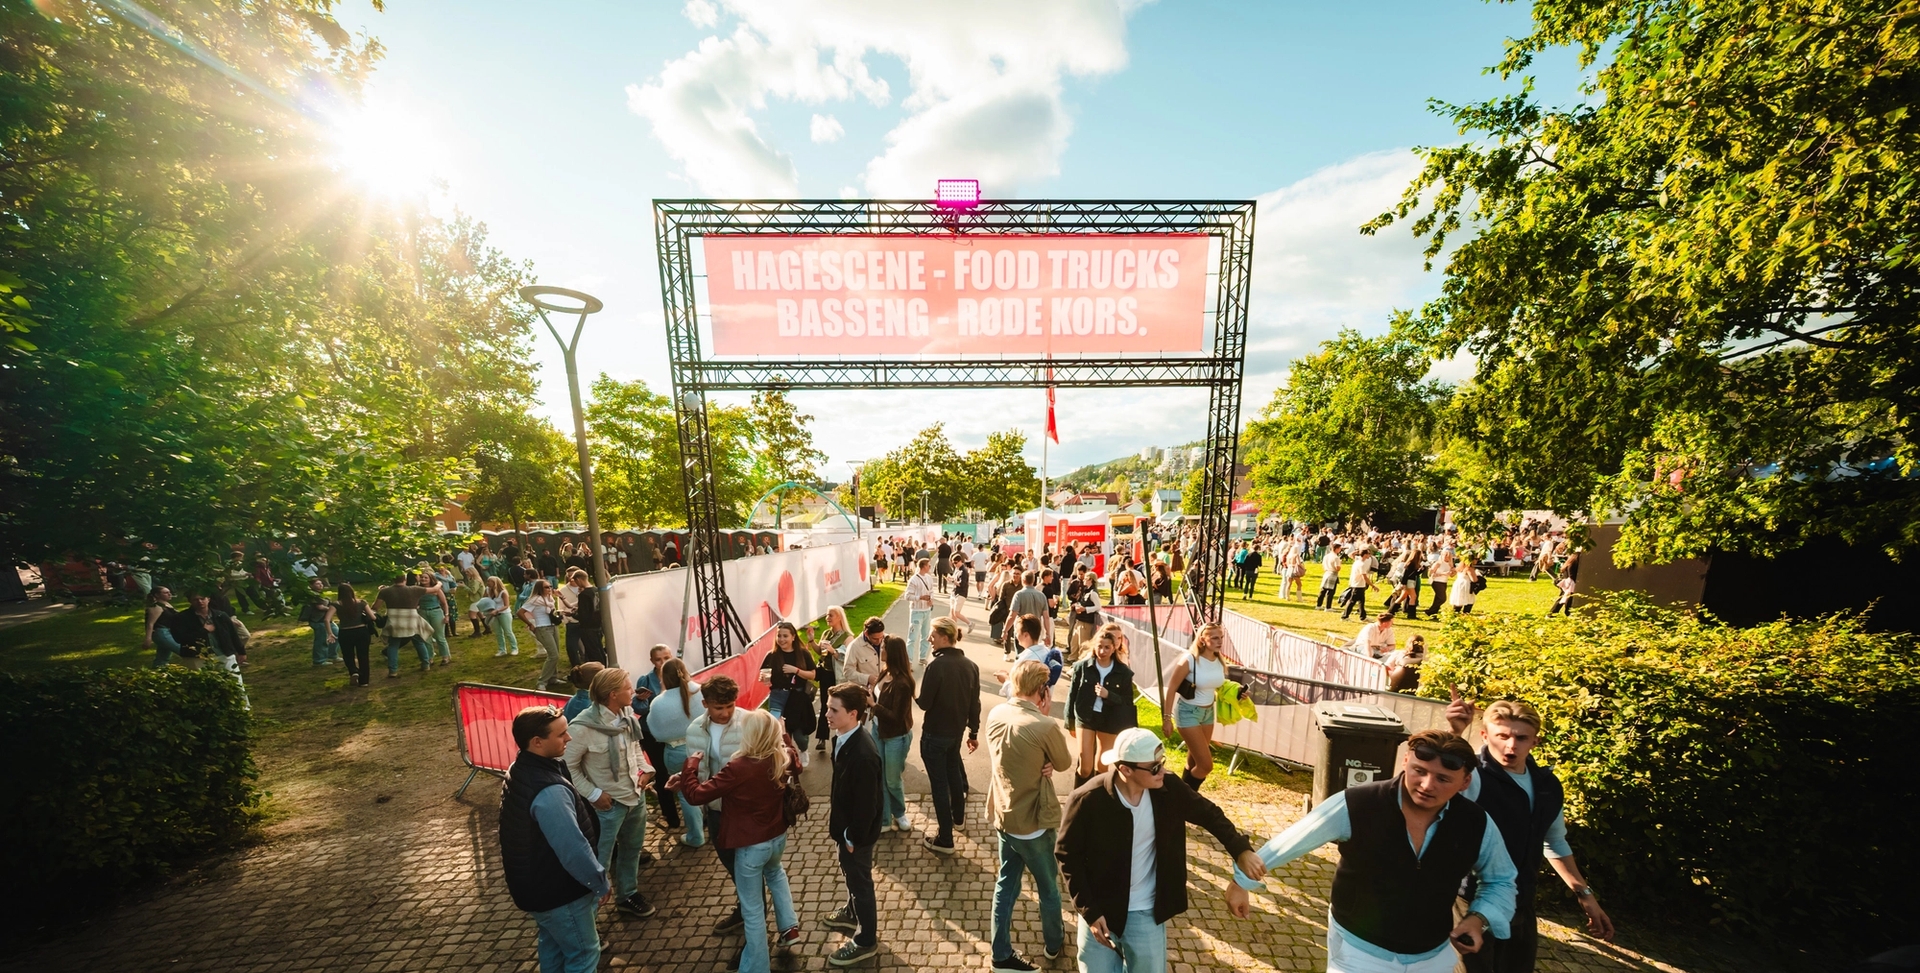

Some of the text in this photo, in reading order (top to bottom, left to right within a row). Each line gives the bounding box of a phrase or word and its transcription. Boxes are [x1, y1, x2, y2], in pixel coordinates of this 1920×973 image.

[731, 248, 1180, 291] HAGESCENE - FOOD TRUCKS
[776, 296, 1148, 338] BASSENG - RØDE KORS.
[1345, 758, 1362, 768] NG
